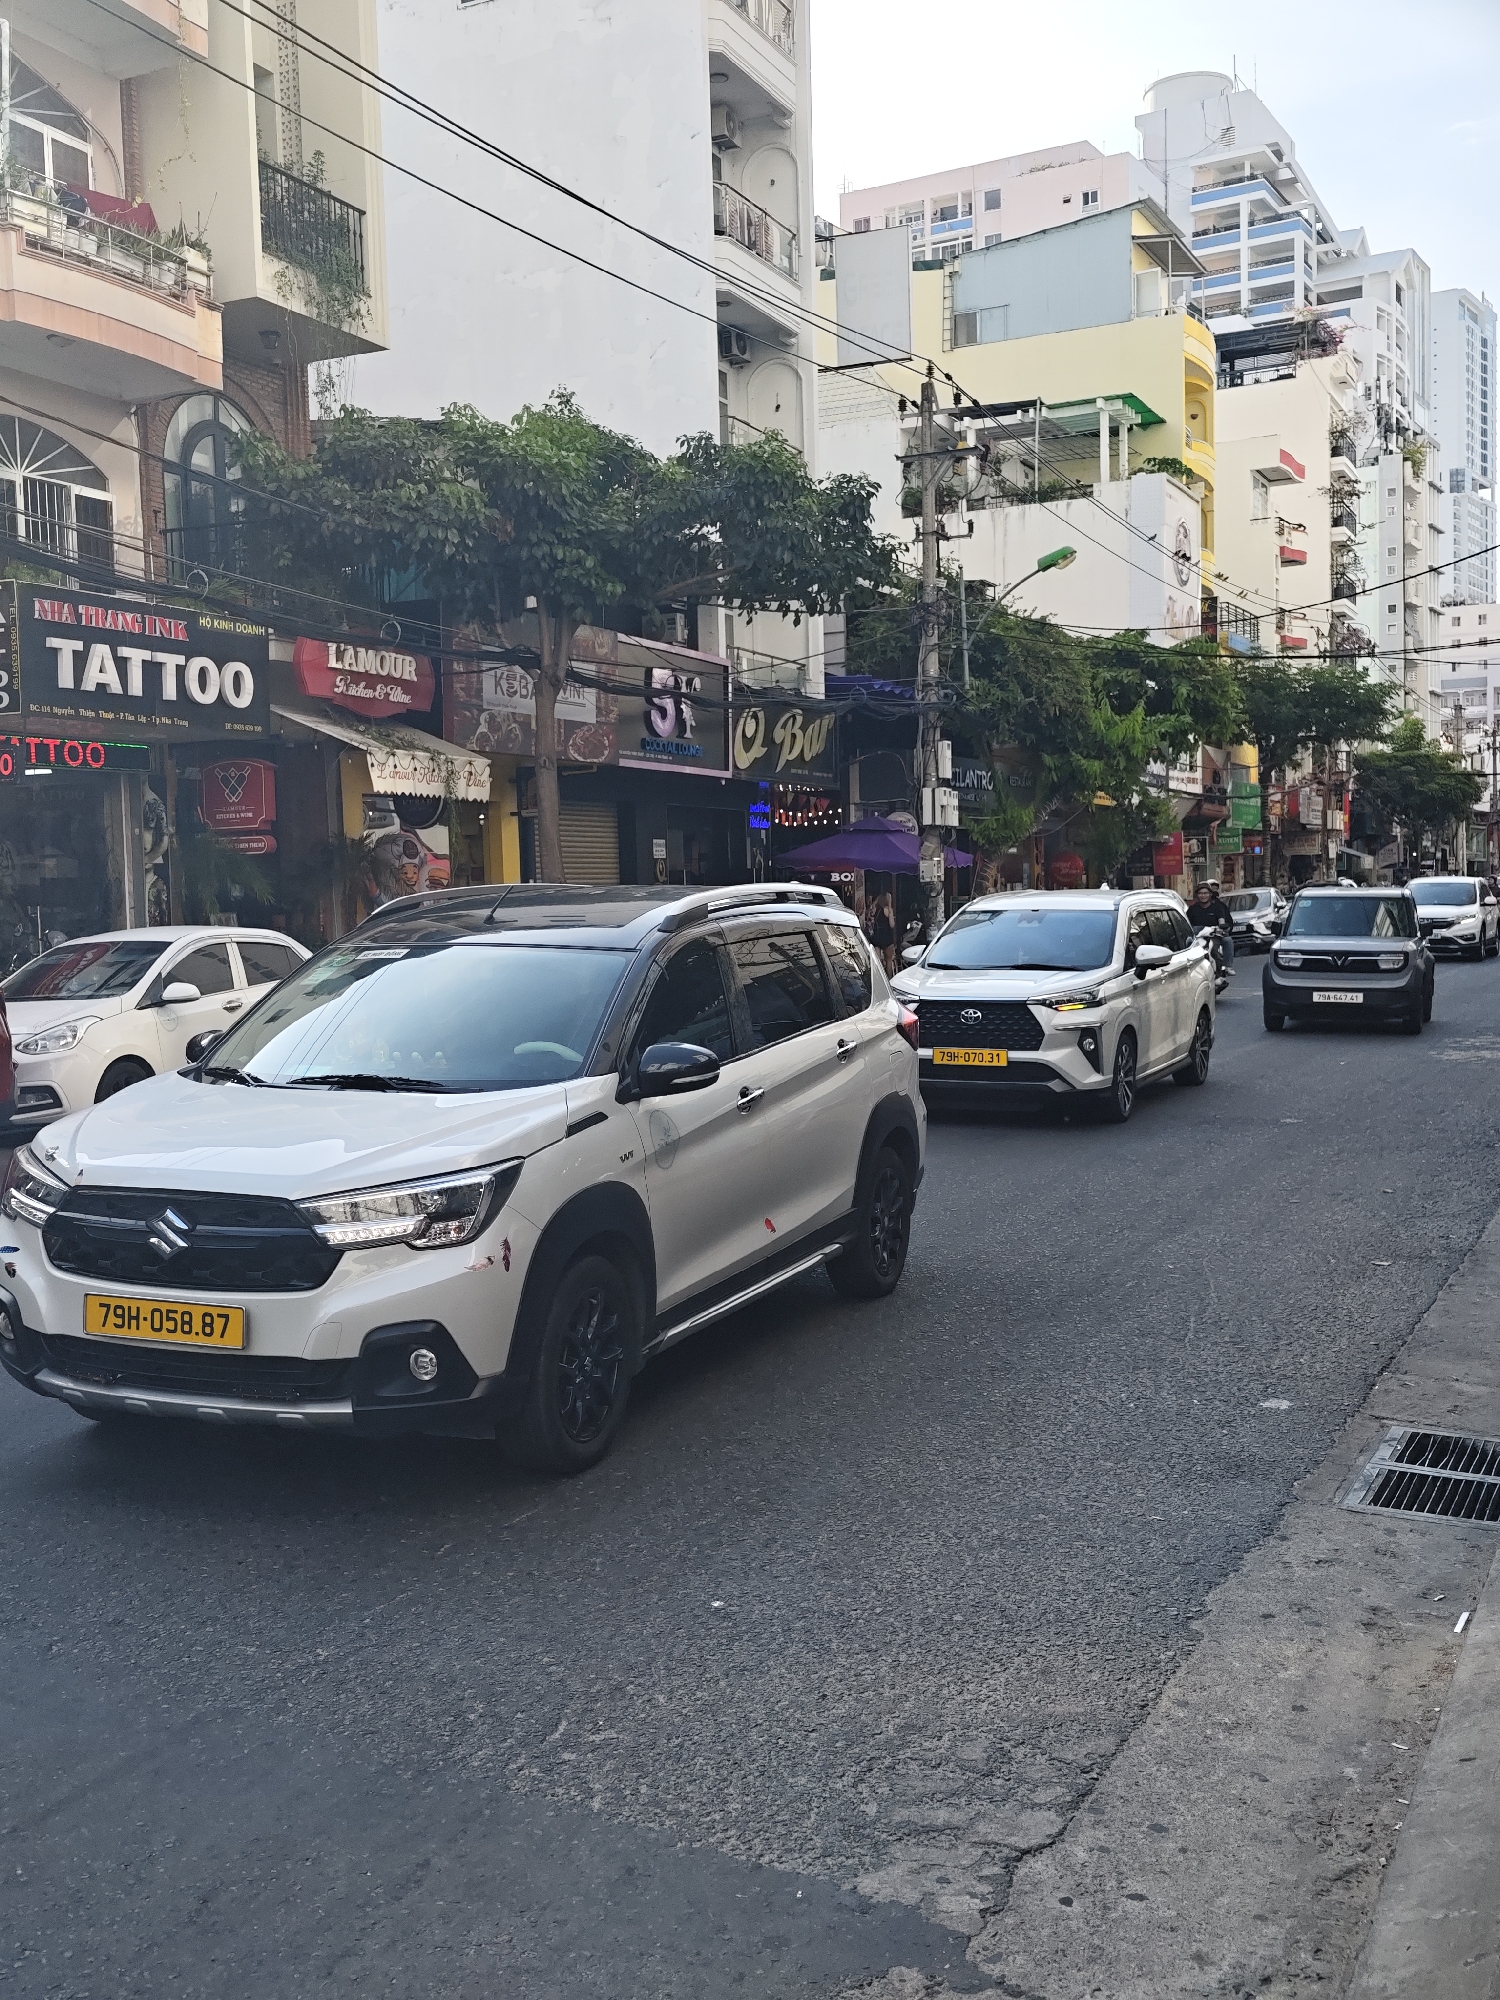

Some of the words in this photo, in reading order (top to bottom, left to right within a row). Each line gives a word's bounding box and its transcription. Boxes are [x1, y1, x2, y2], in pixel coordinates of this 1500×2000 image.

[33, 598, 77, 625] NHA
[78, 604, 143, 634] TRANG
[144, 614, 190, 641] INK
[213, 618, 234, 631] KINH
[236, 622, 265, 636] DOANH
[46, 637, 254, 708] TATTOO
[327, 642, 418, 682] L'AMOUR
[374, 683, 387, 700] &
[387, 684, 412, 704] Wine
[734, 707, 768, 770] Q
[772, 708, 836, 774] Bar
[416, 766, 449, 785] Kitche
[939, 1051, 1000, 1064] 79H-070.31
[98, 1302, 230, 1339] 79H-058.87
